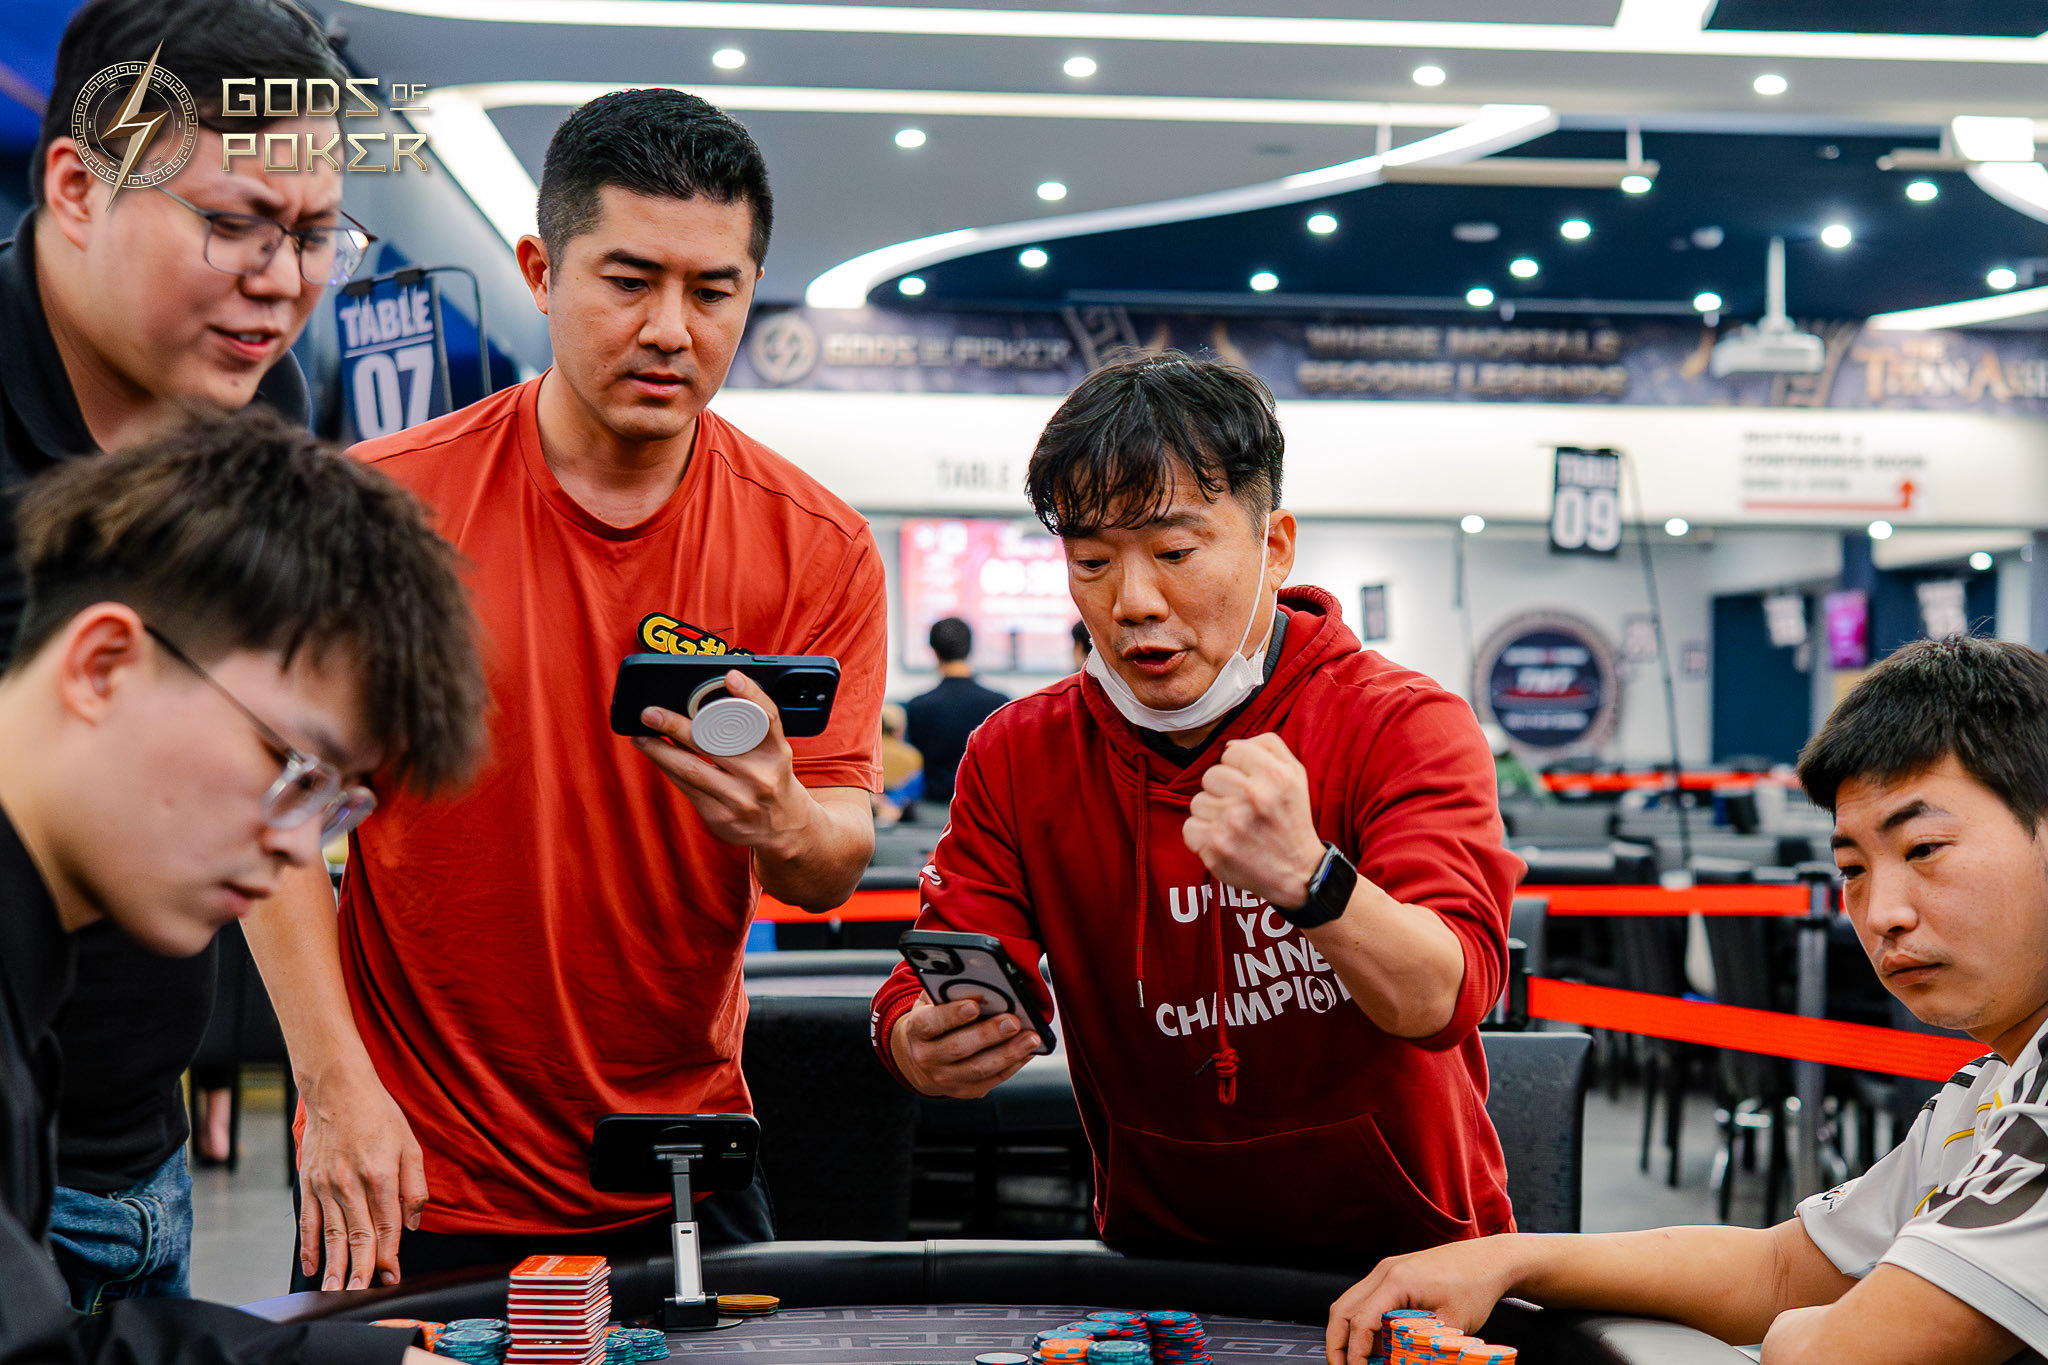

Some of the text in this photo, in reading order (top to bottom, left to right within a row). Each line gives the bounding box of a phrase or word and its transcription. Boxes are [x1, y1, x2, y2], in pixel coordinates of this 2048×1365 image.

[340, 289, 434, 348] TABLE
[822, 332, 918, 367] GODS
[953, 335, 1072, 369] POKER
[352, 343, 435, 440] 07
[1553, 485, 1621, 552] 09
[1233, 936, 1332, 988] INNE
